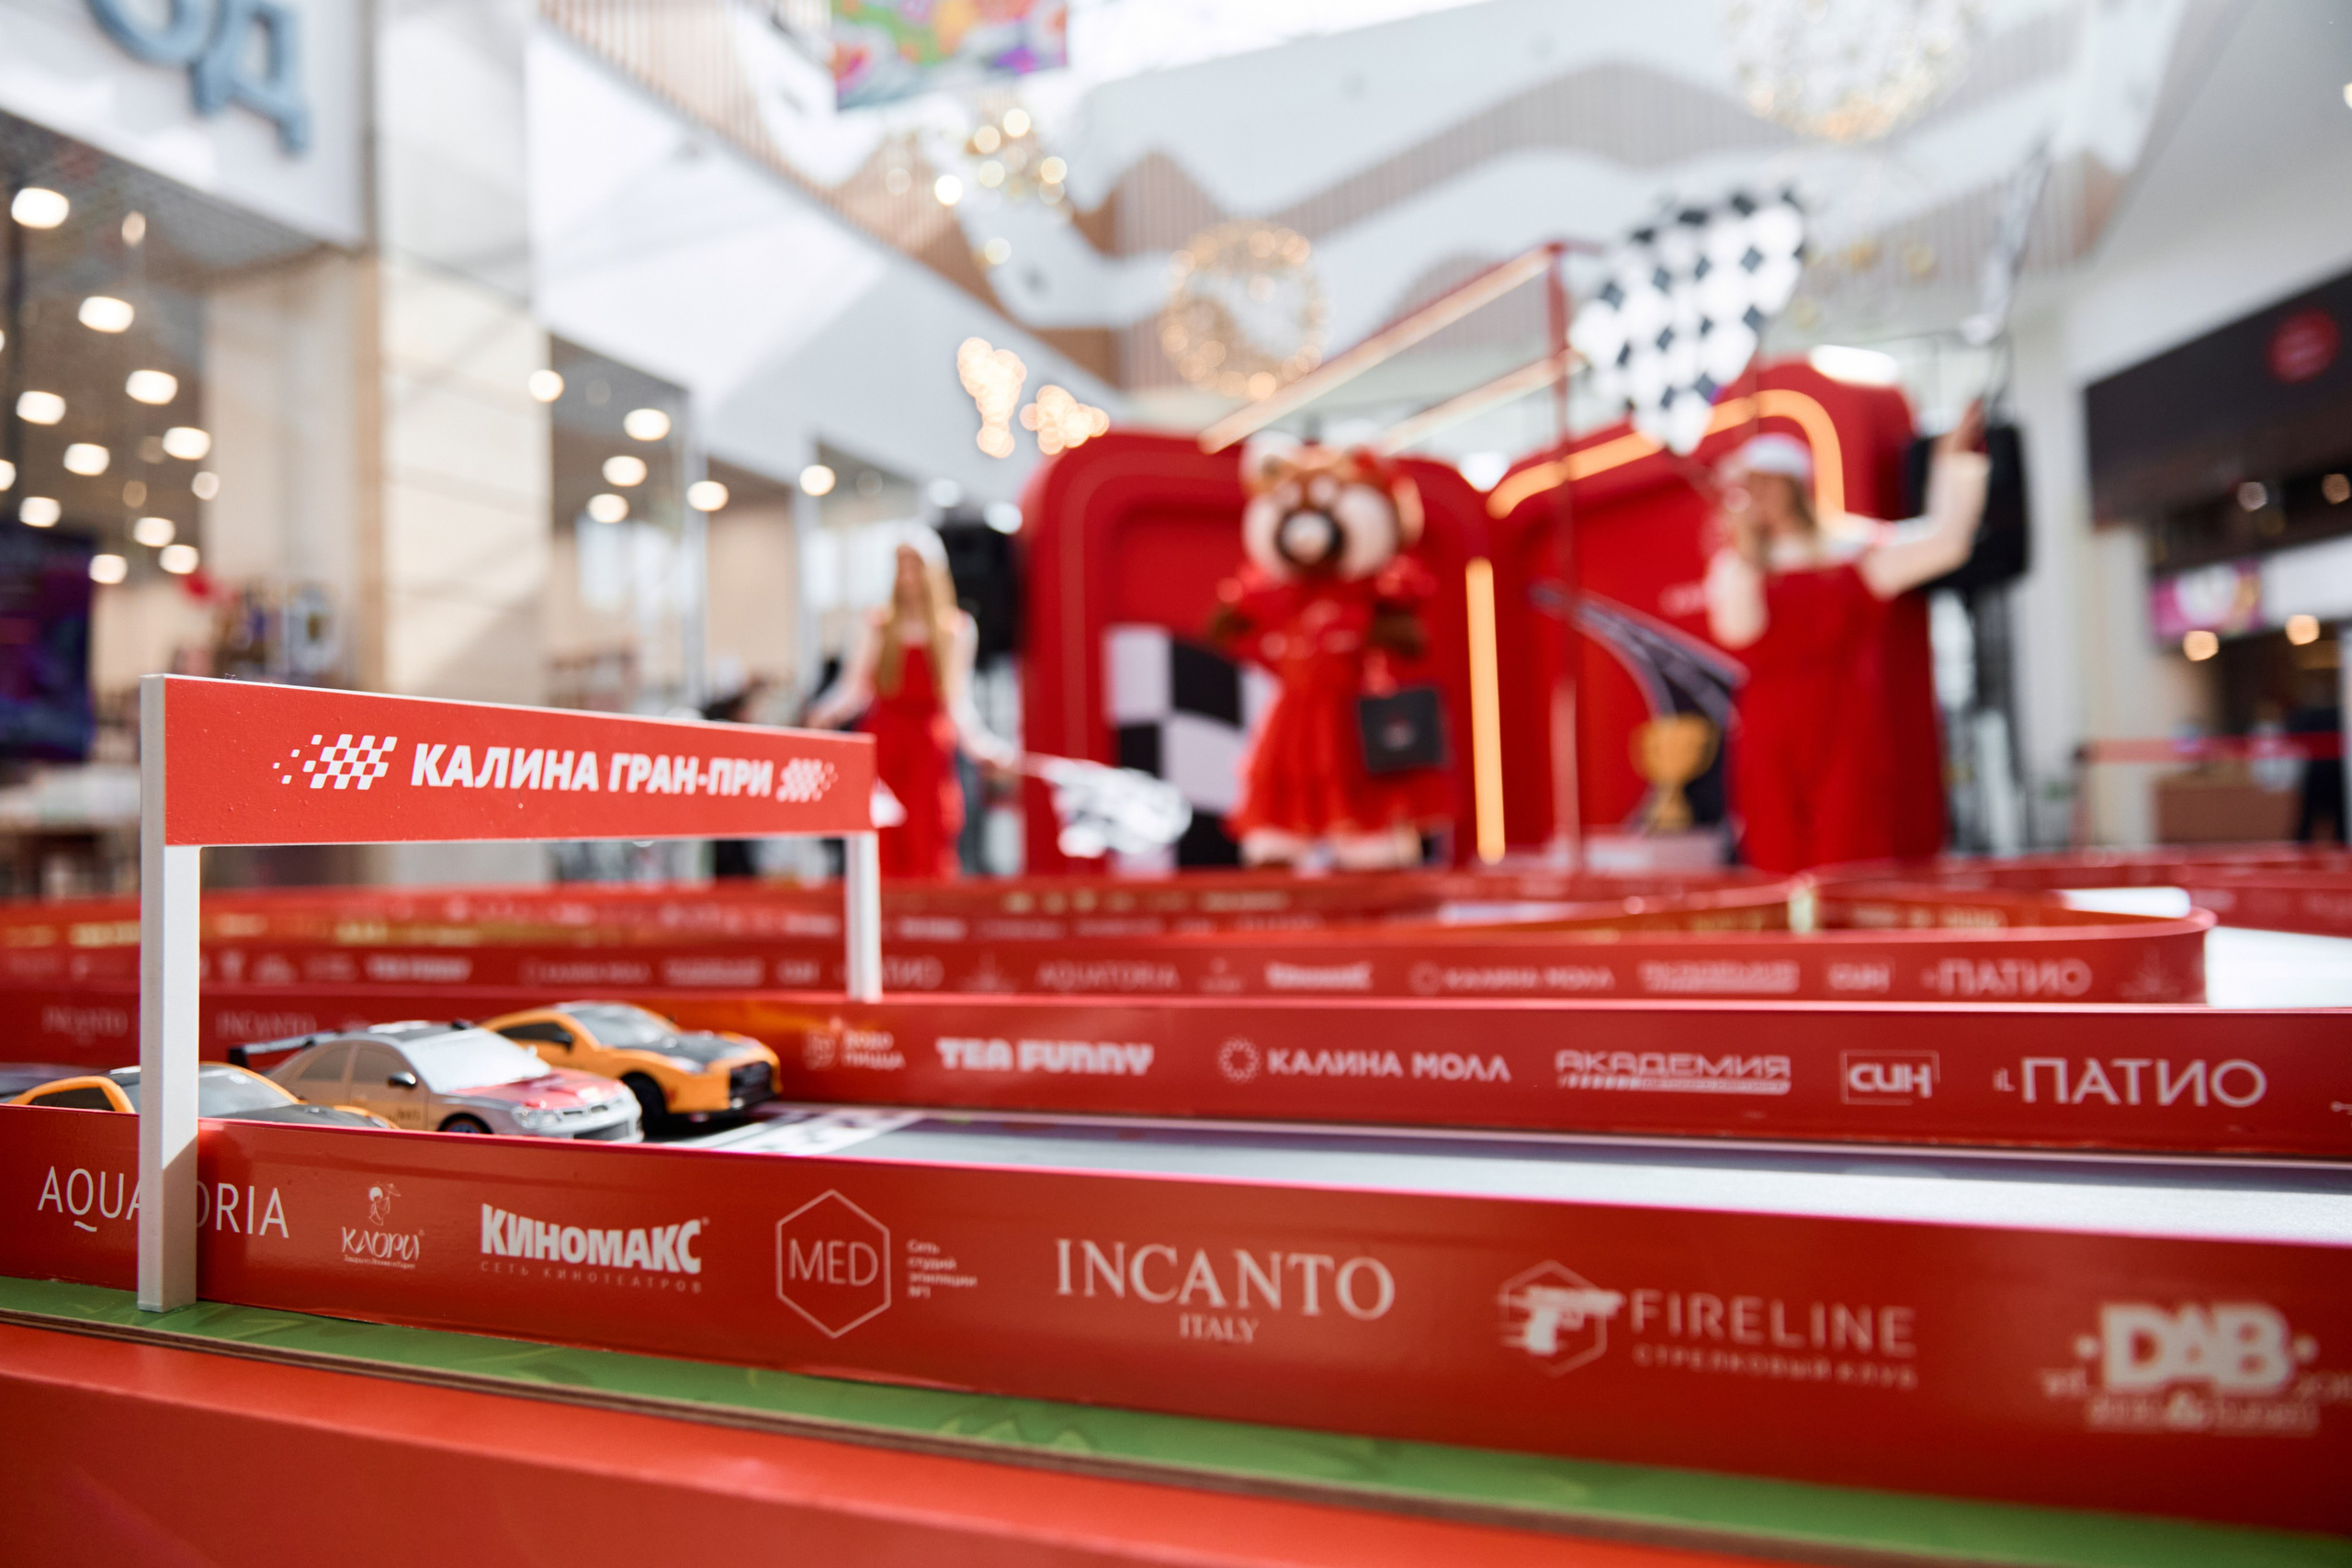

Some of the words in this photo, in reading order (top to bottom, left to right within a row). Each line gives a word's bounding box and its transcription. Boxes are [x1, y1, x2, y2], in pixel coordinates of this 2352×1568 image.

[411, 742, 599, 792] КАЛИНА
[608, 751, 775, 798] ГРАН-ПРИ
[935, 1036, 1013, 1072] TEA
[1267, 1047, 1404, 1078] КАЛИНА
[1411, 1050, 1512, 1083] МОЛЛ
[1554, 1049, 1792, 1079] АКАДЕМИЯ
[2021, 1056, 2268, 1108] ПАТИО
[37, 1165, 289, 1239] AQURIA
[481, 1203, 702, 1275] КИНОМАКС
[788, 1238, 879, 1286] MED
[481, 1260, 530, 1277] СЕТЬ
[543, 1267, 703, 1294] КИНОТЕАТРОВ
[1055, 1237, 1396, 1321] INCANTO
[1178, 1312, 1260, 1345] ITALY
[1629, 1287, 1918, 1359] FIRELINE
[2100, 1301, 2294, 1394] DAB
